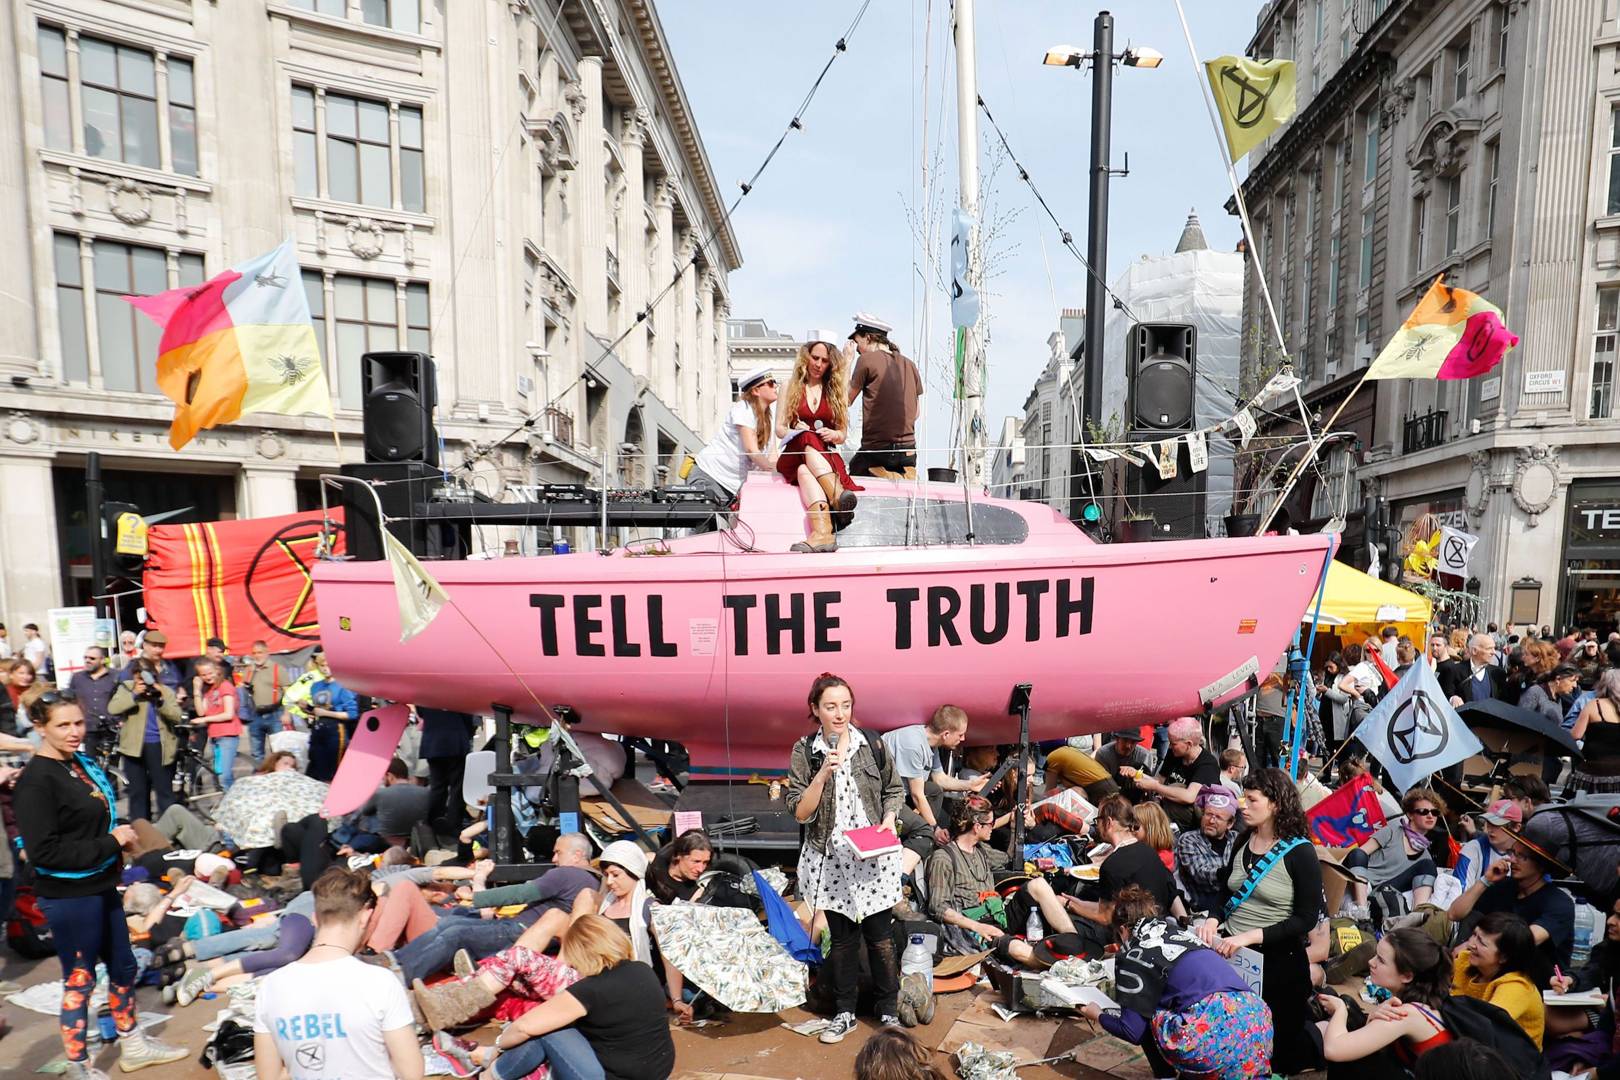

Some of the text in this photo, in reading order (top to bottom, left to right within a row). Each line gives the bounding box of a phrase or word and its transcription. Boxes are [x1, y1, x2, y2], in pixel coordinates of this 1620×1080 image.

[68, 427, 228, 448] NIKETWN
[529, 593, 678, 658] TELL
[722, 591, 842, 656] THE
[886, 576, 1095, 651] TRUTH
[274, 1013, 348, 1041] REBEL
